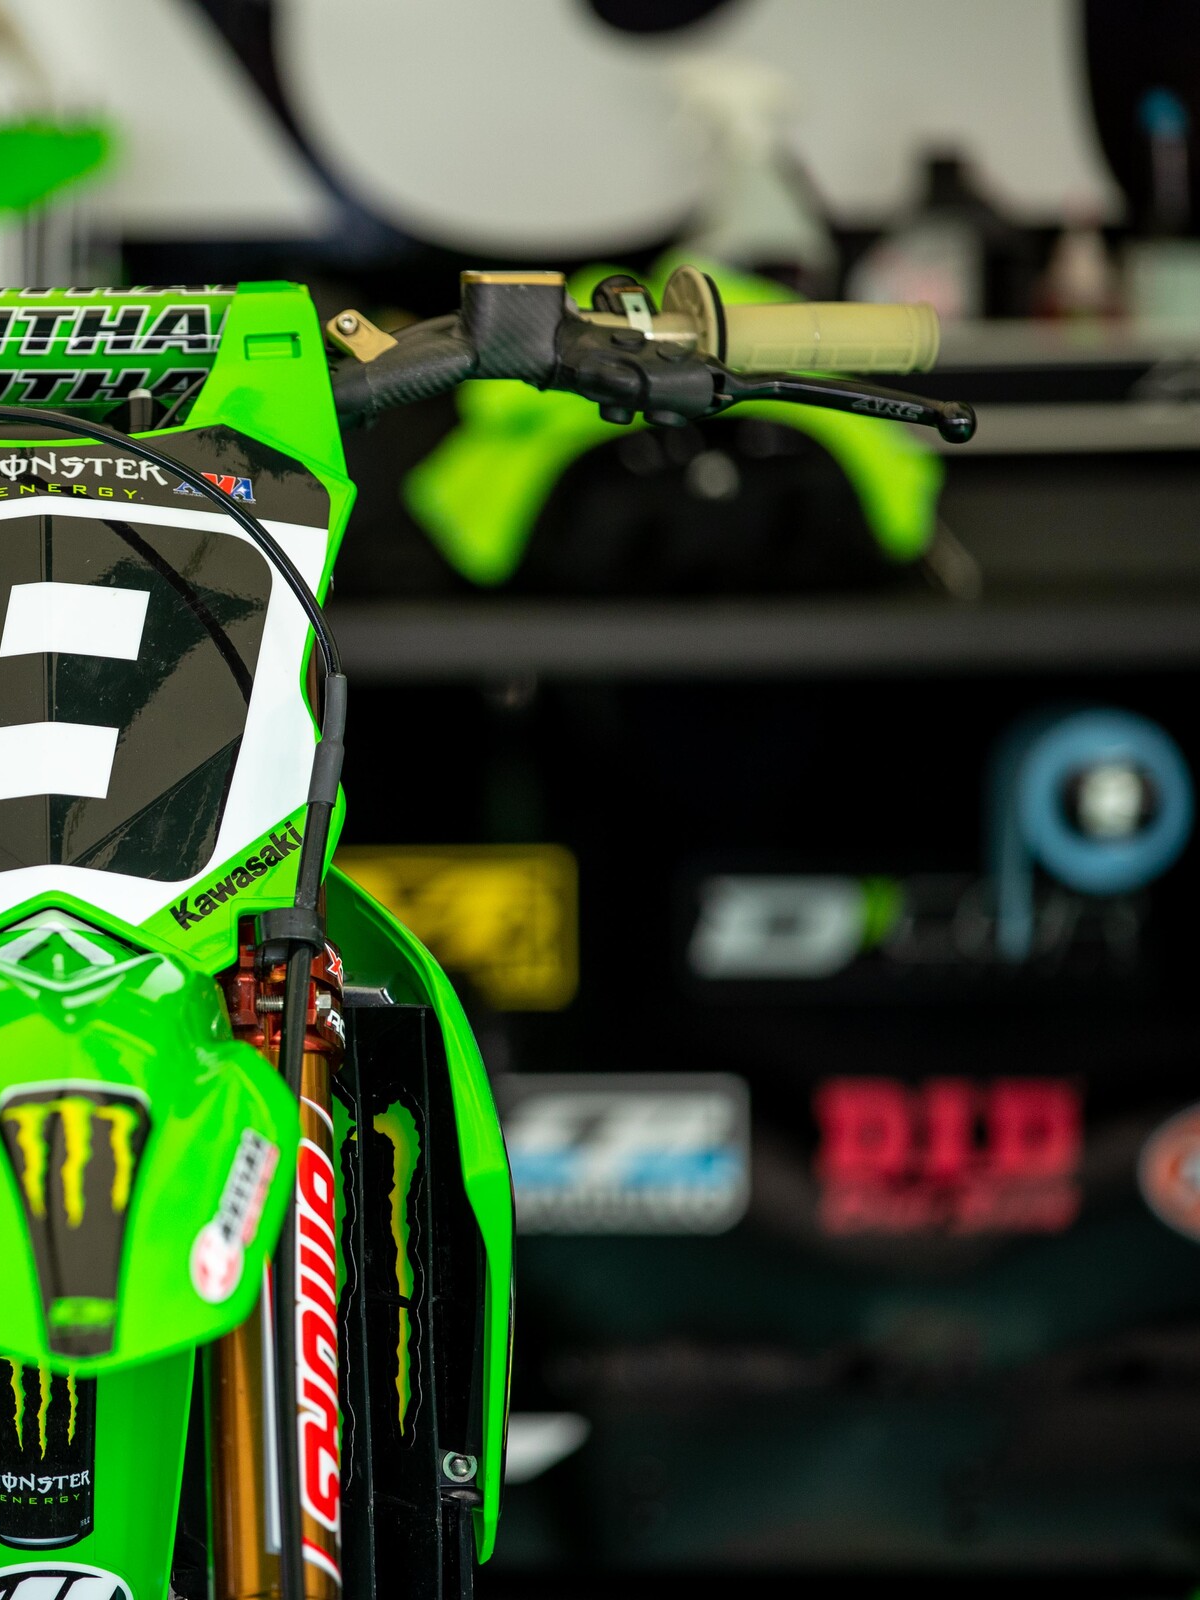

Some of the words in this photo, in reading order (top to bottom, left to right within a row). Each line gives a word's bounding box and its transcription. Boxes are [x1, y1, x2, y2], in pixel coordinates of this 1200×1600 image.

[851, 397, 924, 420] ARC
[169, 821, 303, 931] Kawasaki
[0, 1493, 80, 1505] ENERGY
